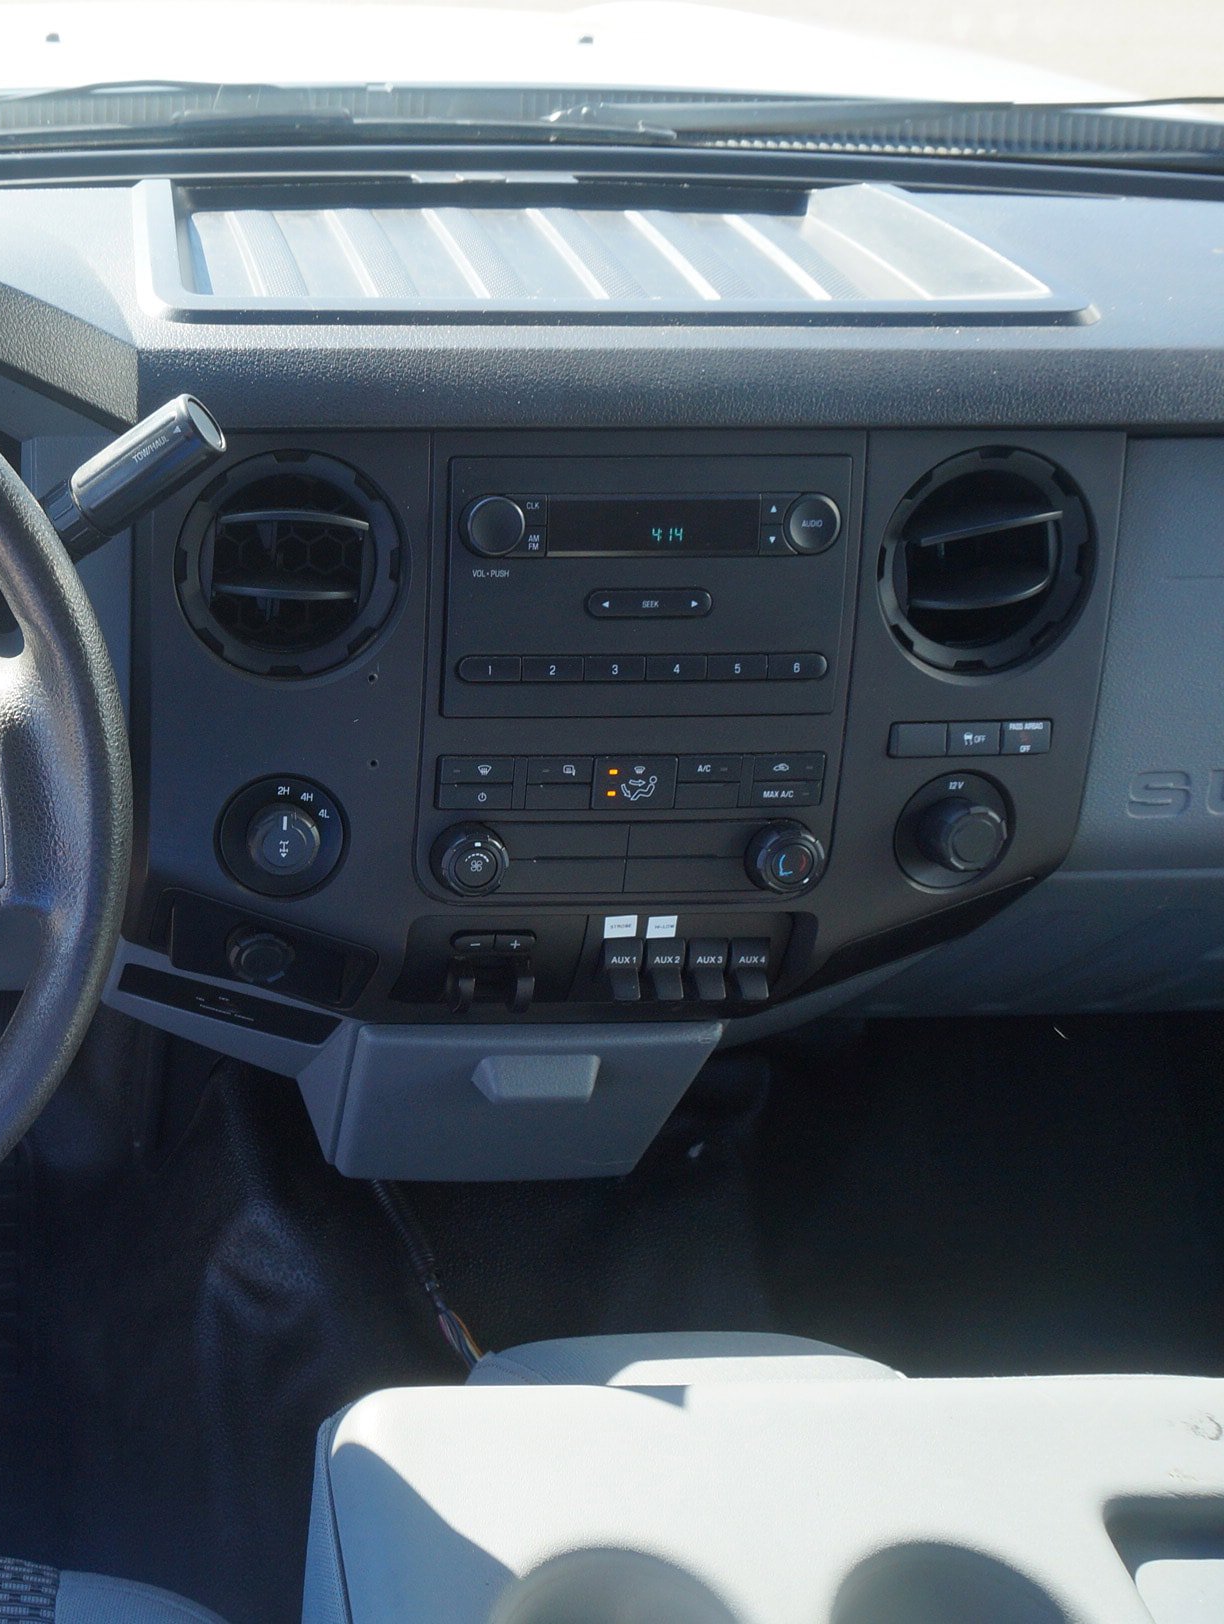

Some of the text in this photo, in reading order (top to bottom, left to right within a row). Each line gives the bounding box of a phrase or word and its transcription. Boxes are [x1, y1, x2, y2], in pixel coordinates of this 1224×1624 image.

[132, 435, 170, 463] TOW/HAUL
[526, 502, 540, 510] CLK
[801, 519, 823, 528] AUDIO
[528, 534, 540, 543] AM
[528, 542, 539, 551] FM
[472, 569, 510, 578] VOL PUSH
[642, 600, 660, 608] SEEK
[487, 664, 493, 676] 1
[549, 664, 556, 676] 2
[611, 664, 619, 676] 3
[673, 663, 681, 675] 4
[734, 662, 742, 674] 5
[793, 662, 801, 674] 6
[1019, 744, 1031, 753] OFF
[697, 764, 712, 773] A/C
[277, 786, 290, 796] 2H
[763, 790, 794, 799] MAX A/C
[300, 793, 313, 802] 4H
[318, 809, 330, 819] 4L
[611, 955, 637, 964] AUX 1
[654, 955, 681, 964] AUX 2
[696, 955, 723, 964] AUX 3
[739, 955, 766, 964] AUX 4
